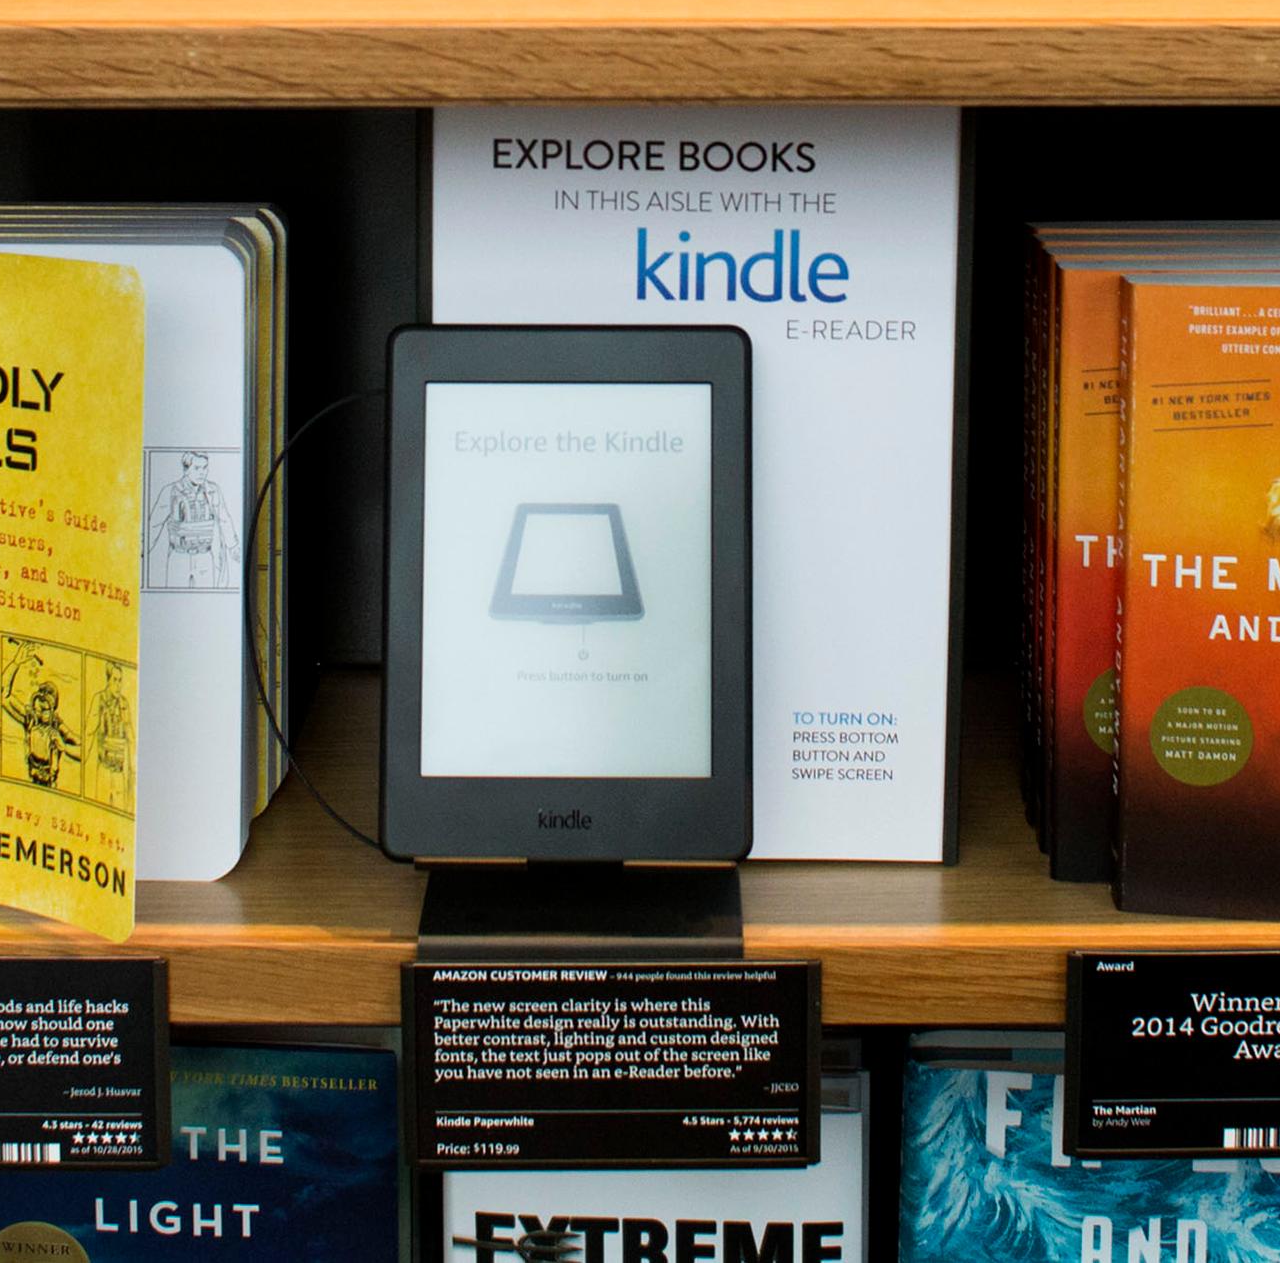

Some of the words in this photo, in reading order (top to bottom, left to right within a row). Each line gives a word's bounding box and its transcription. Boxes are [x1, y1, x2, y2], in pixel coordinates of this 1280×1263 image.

[493, 138, 665, 170] EXPLORE
[679, 140, 815, 172] BOOKS
[555, 189, 579, 210] IN
[586, 189, 639, 211] THIS
[645, 190, 712, 212] AISLE
[719, 191, 781, 212] WITH
[788, 192, 836, 213] THE
[637, 227, 849, 303] kindle
[786, 319, 916, 340] E-READER
[455, 432, 546, 456] Explore
[556, 430, 596, 452] the
[605, 430, 684, 455] Kindle
[63, 508, 106, 533] Guide
[1142, 553, 1237, 589] THE
[21, 566, 48, 583] and
[57, 570, 130, 607] Surviving
[792, 711, 814, 724] TO
[819, 712, 862, 725] TURN
[792, 731, 835, 743] PRESS
[839, 732, 898, 744] BOTTOM
[792, 749, 849, 762] BUTTON
[852, 750, 885, 762] AND
[791, 767, 833, 779] SWIPE
[837, 768, 893, 780] SCREEN
[537, 807, 592, 830] kindle
[433, 970, 487, 981] AMAZON
[491, 970, 557, 981] CUSTOMER
[561, 970, 607, 981] REVIEW
[1096, 961, 1133, 971] Award
[31, 1016, 83, 1030] should
[85, 1019, 114, 1031] one
[1132, 1017, 1194, 1036] 2014
[436, 1116, 471, 1126] Kindle
[474, 1116, 534, 1128] Paperwhite
[180, 1126, 284, 1166] THE
[436, 1143, 470, 1155] Price:
[473, 1142, 519, 1154] $119.99
[95, 1197, 259, 1237] LIGHT
